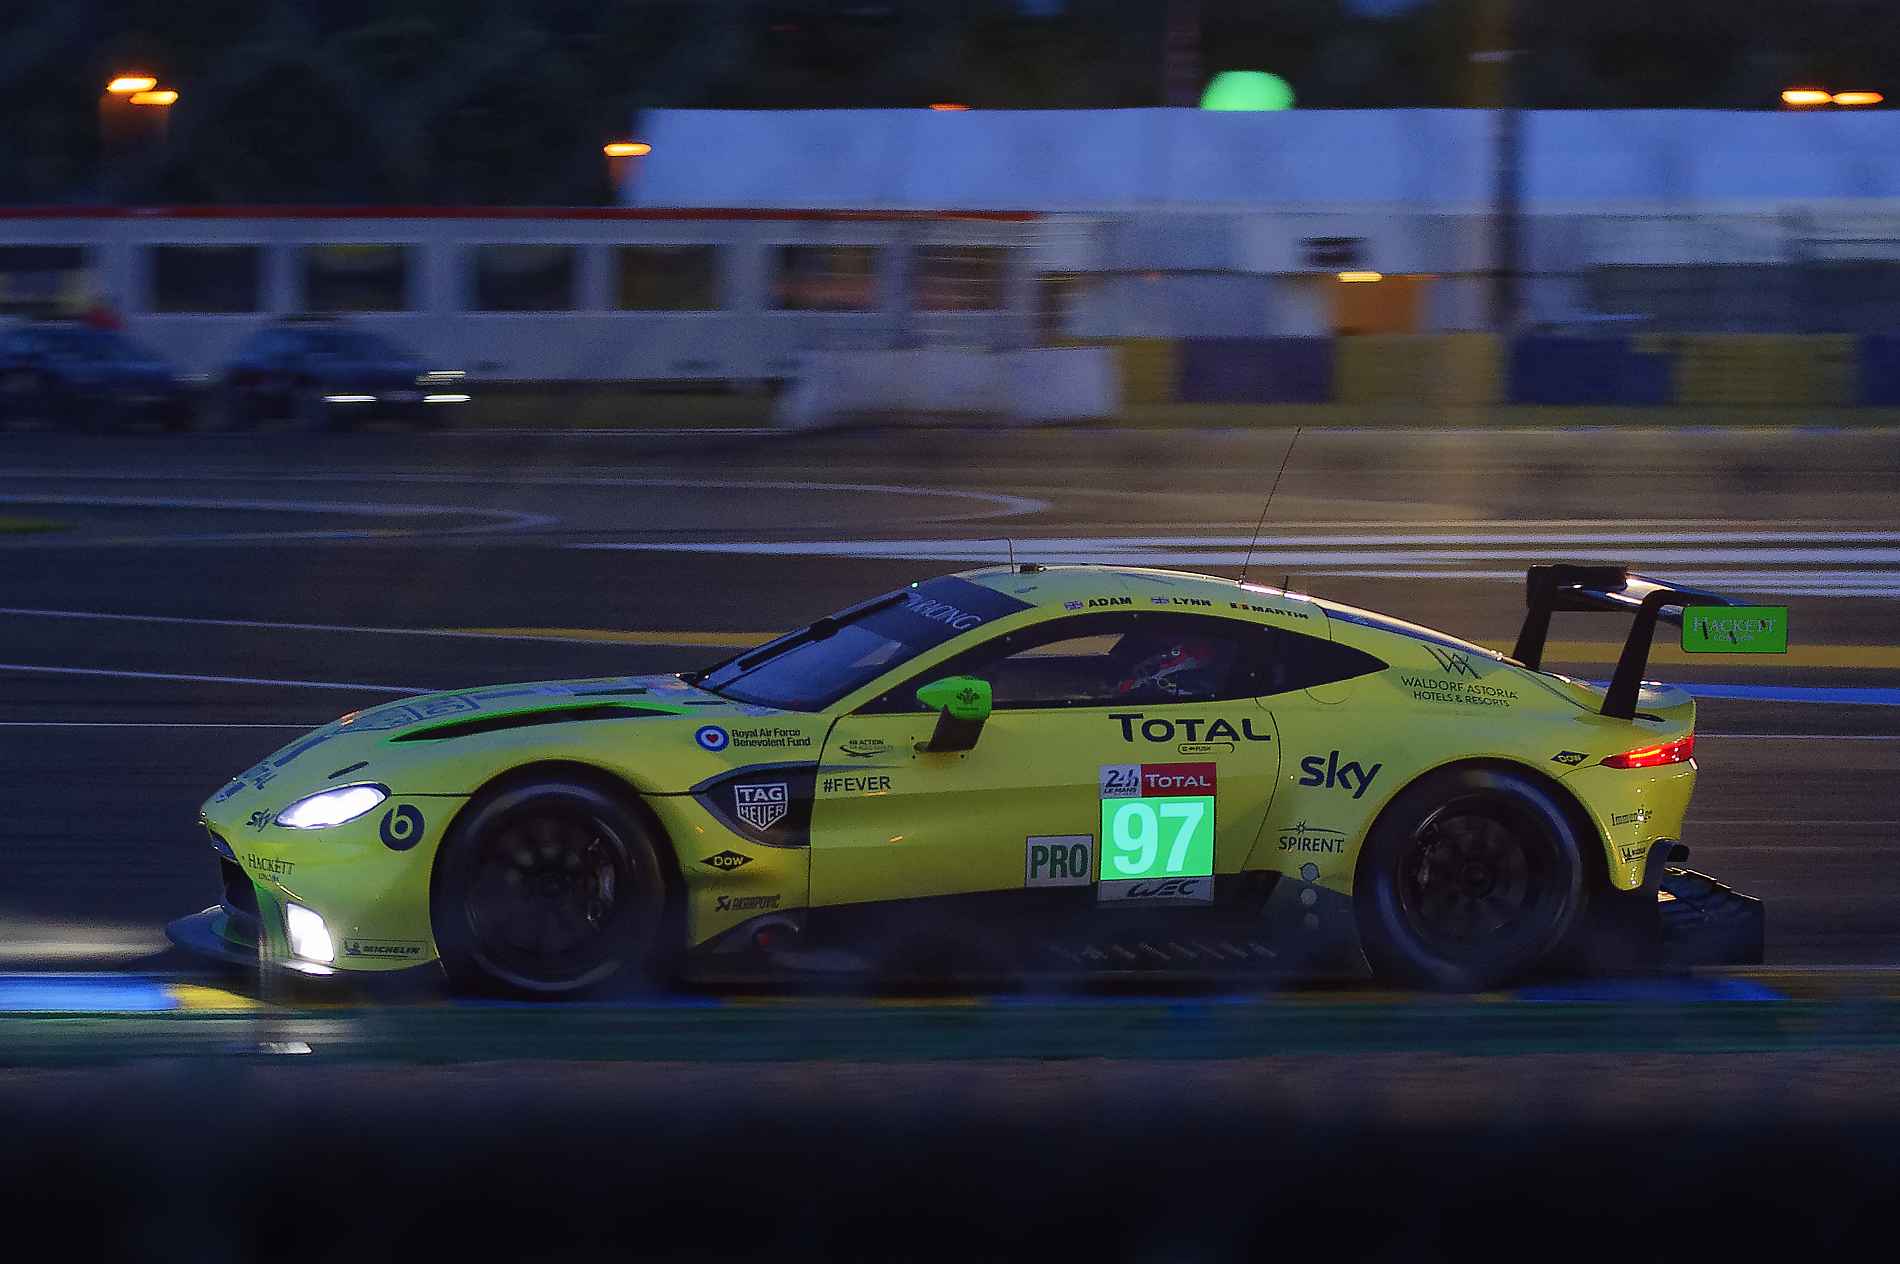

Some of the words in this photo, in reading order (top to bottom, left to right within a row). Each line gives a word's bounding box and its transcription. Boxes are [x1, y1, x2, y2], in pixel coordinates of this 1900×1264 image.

[1088, 597, 1133, 608] ADAM
[1173, 597, 1212, 607] LYNN
[1251, 605, 1309, 620] MARTIN
[1400, 675, 1464, 692] WALDORF
[1467, 684, 1519, 700] ASTORIA
[1413, 690, 1453, 702] HOTELS
[1465, 695, 1511, 707] RESORTS
[731, 729, 758, 739] Royal
[760, 729, 772, 737] Air
[774, 728, 801, 737] Force
[733, 738, 786, 747] Benevolent
[787, 737, 811, 747] Fund
[1144, 773, 1212, 788] TOTAL
[1299, 750, 1382, 799] sky
[823, 776, 892, 793] #FEVER
[740, 787, 784, 801] TAG
[740, 805, 785, 827] HEUER
[1112, 802, 1206, 875] 97
[247, 853, 296, 875] HACKETT
[1030, 844, 1089, 879] PRO
[1127, 879, 1200, 897] WEC
[362, 945, 421, 955] MICHELIN
